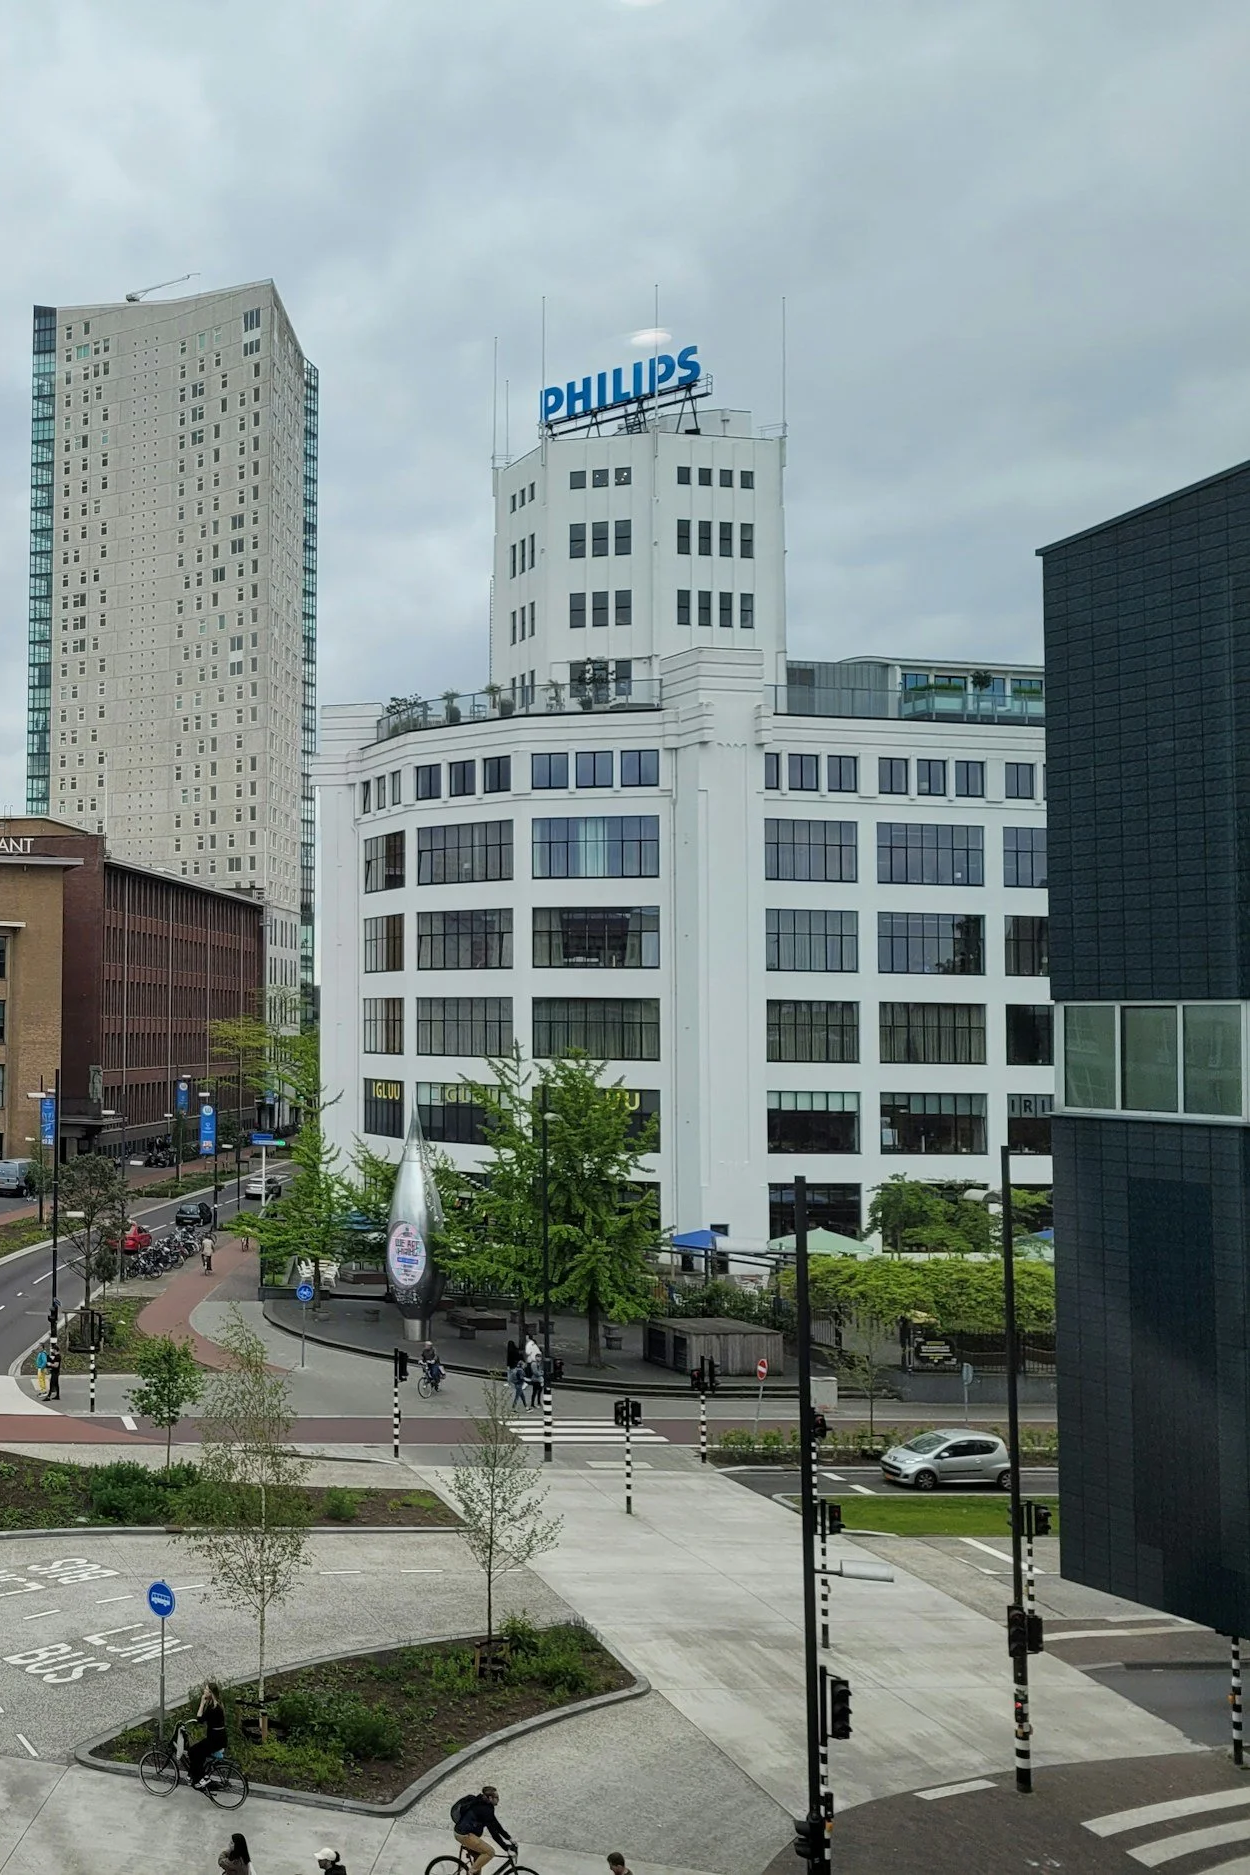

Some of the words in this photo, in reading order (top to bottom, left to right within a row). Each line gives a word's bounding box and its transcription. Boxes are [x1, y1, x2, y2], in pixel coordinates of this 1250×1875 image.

[540, 346, 702, 422] PHILIPS
[372, 1081, 401, 1100] IGLUU
[27, 1558, 120, 1584] BUS
[82, 1623, 194, 1663] LIJN
[2, 1643, 111, 1684] BUS
